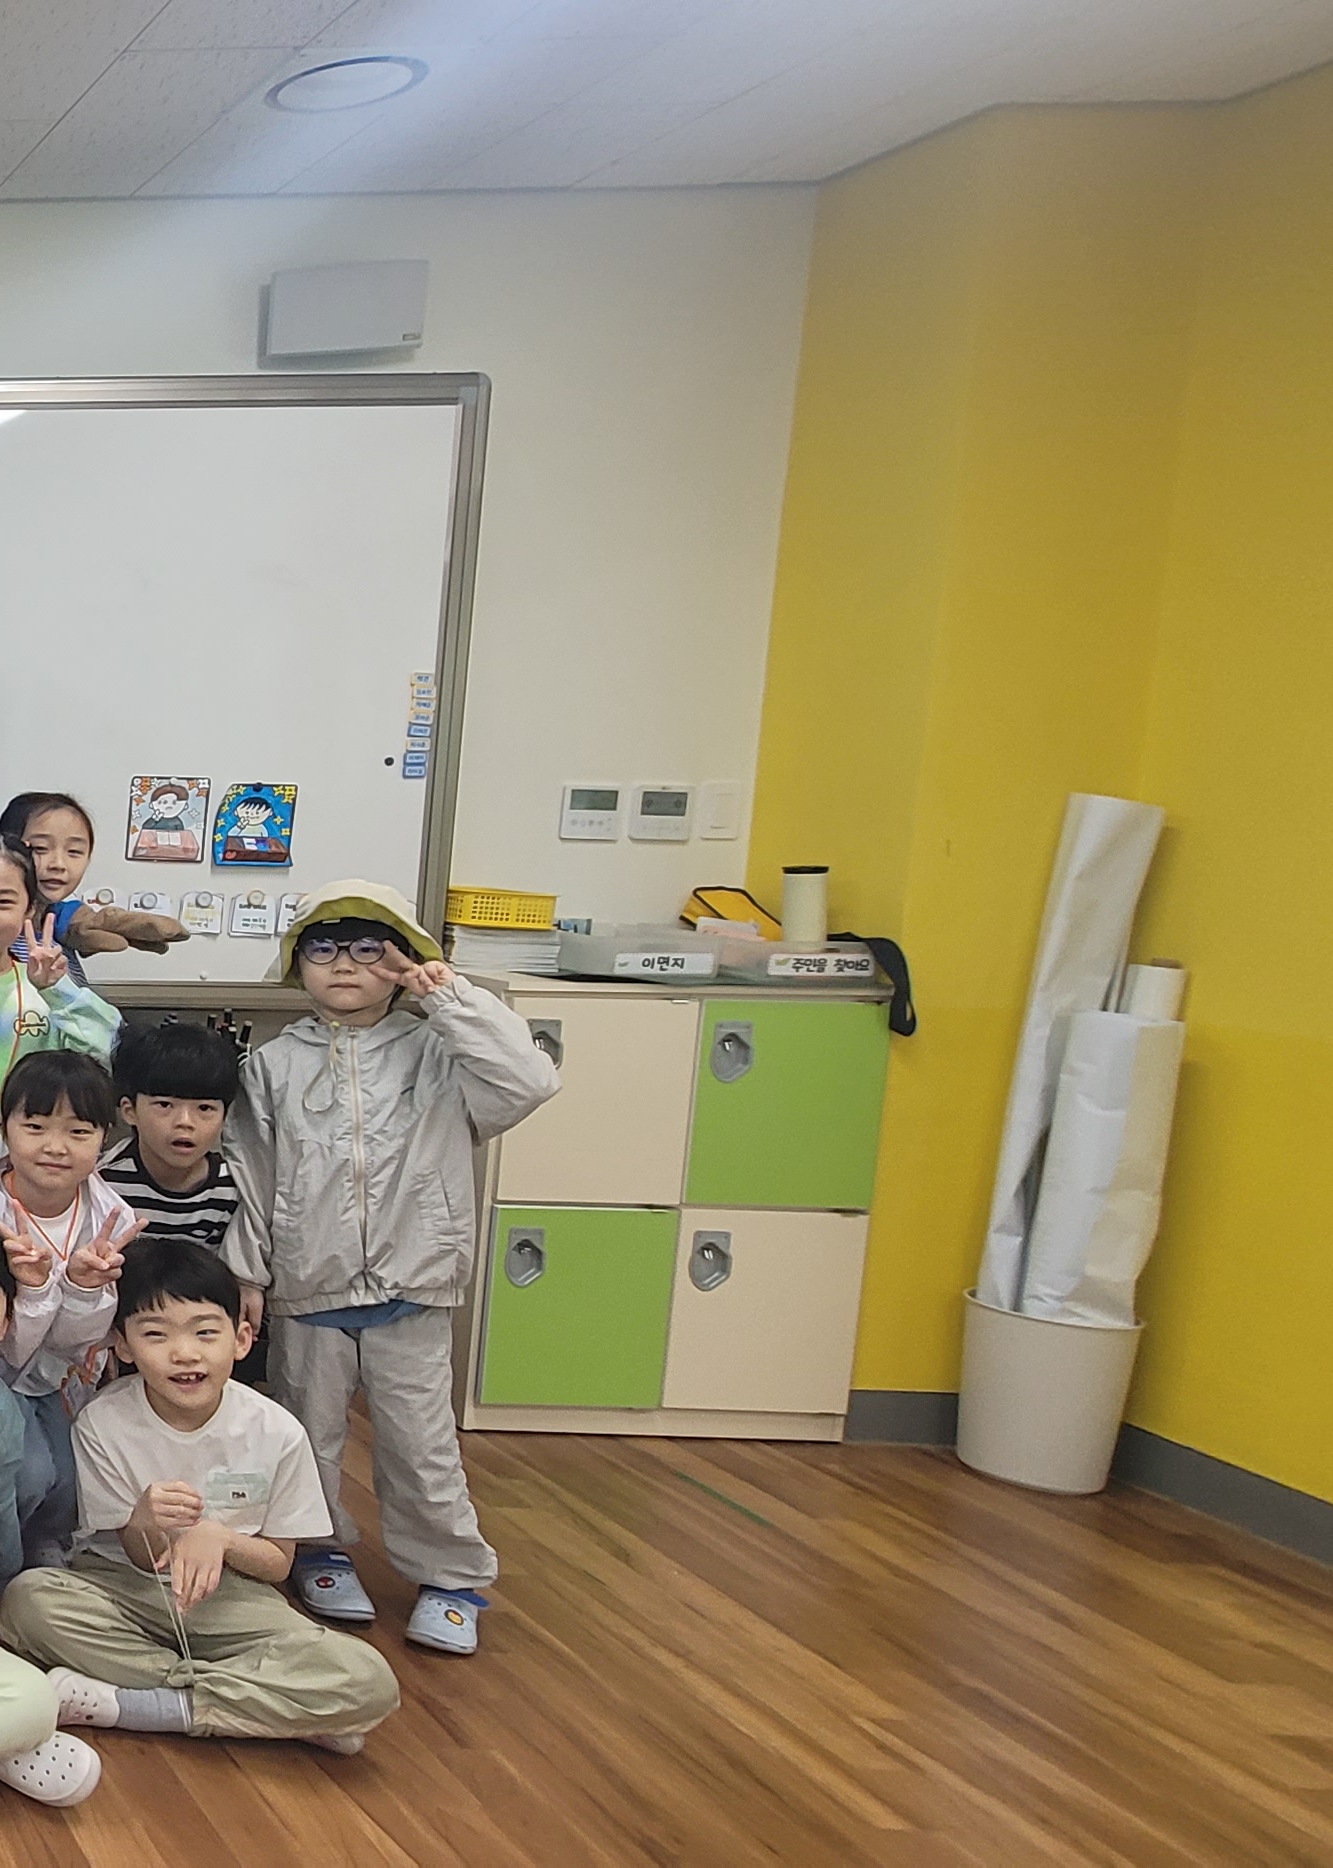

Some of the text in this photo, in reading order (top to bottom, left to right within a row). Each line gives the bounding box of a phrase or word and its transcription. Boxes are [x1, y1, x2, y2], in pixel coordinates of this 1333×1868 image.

[641, 957, 686, 972] 이면지
[791, 957, 870, 973] 주인을 찾아요
